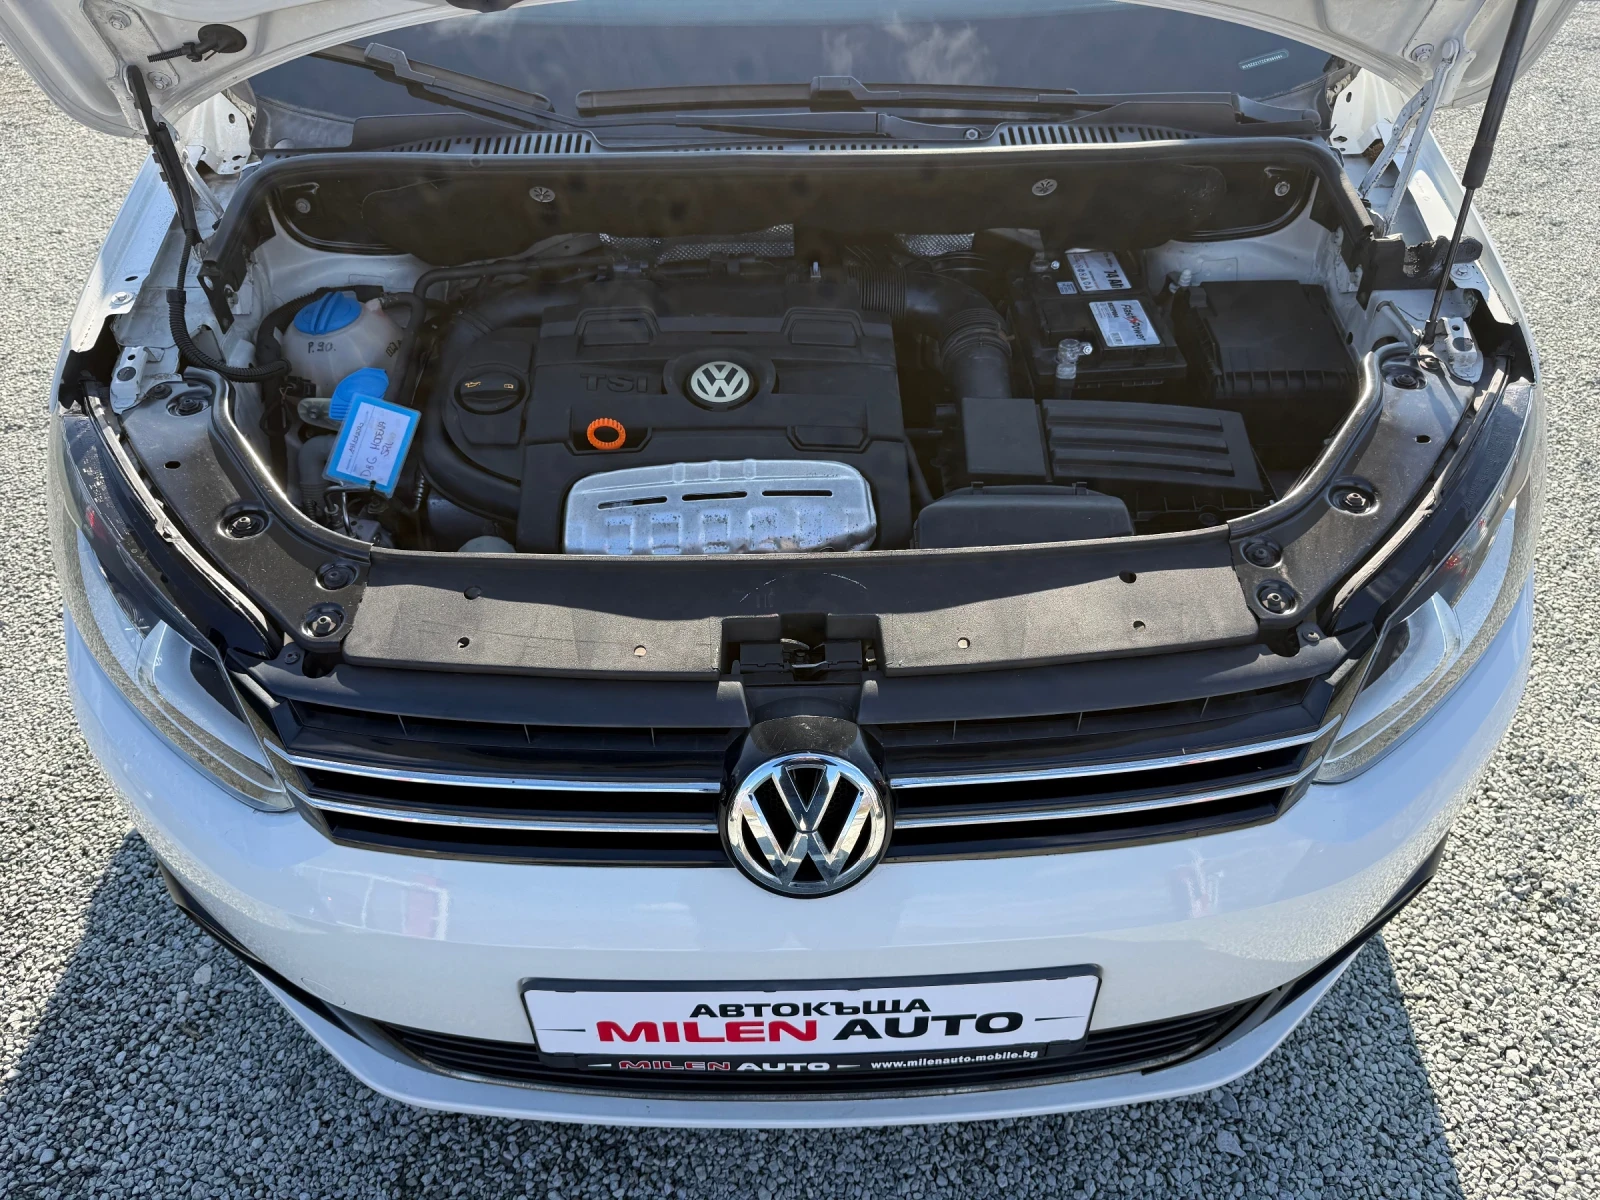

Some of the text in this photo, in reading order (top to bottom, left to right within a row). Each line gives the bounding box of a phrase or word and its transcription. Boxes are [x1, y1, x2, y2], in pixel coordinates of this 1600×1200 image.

[1104, 269, 1119, 278] 74
[1108, 279, 1124, 288] Ah
[580, 373, 648, 393] TSI
[728, 753, 886, 894] VW
[596, 1012, 1024, 1042] MILEN AUTO
[618, 1060, 831, 1072] MILEN AUTO
[871, 1050, 1039, 1069] www.milenauto.mobile.bg
